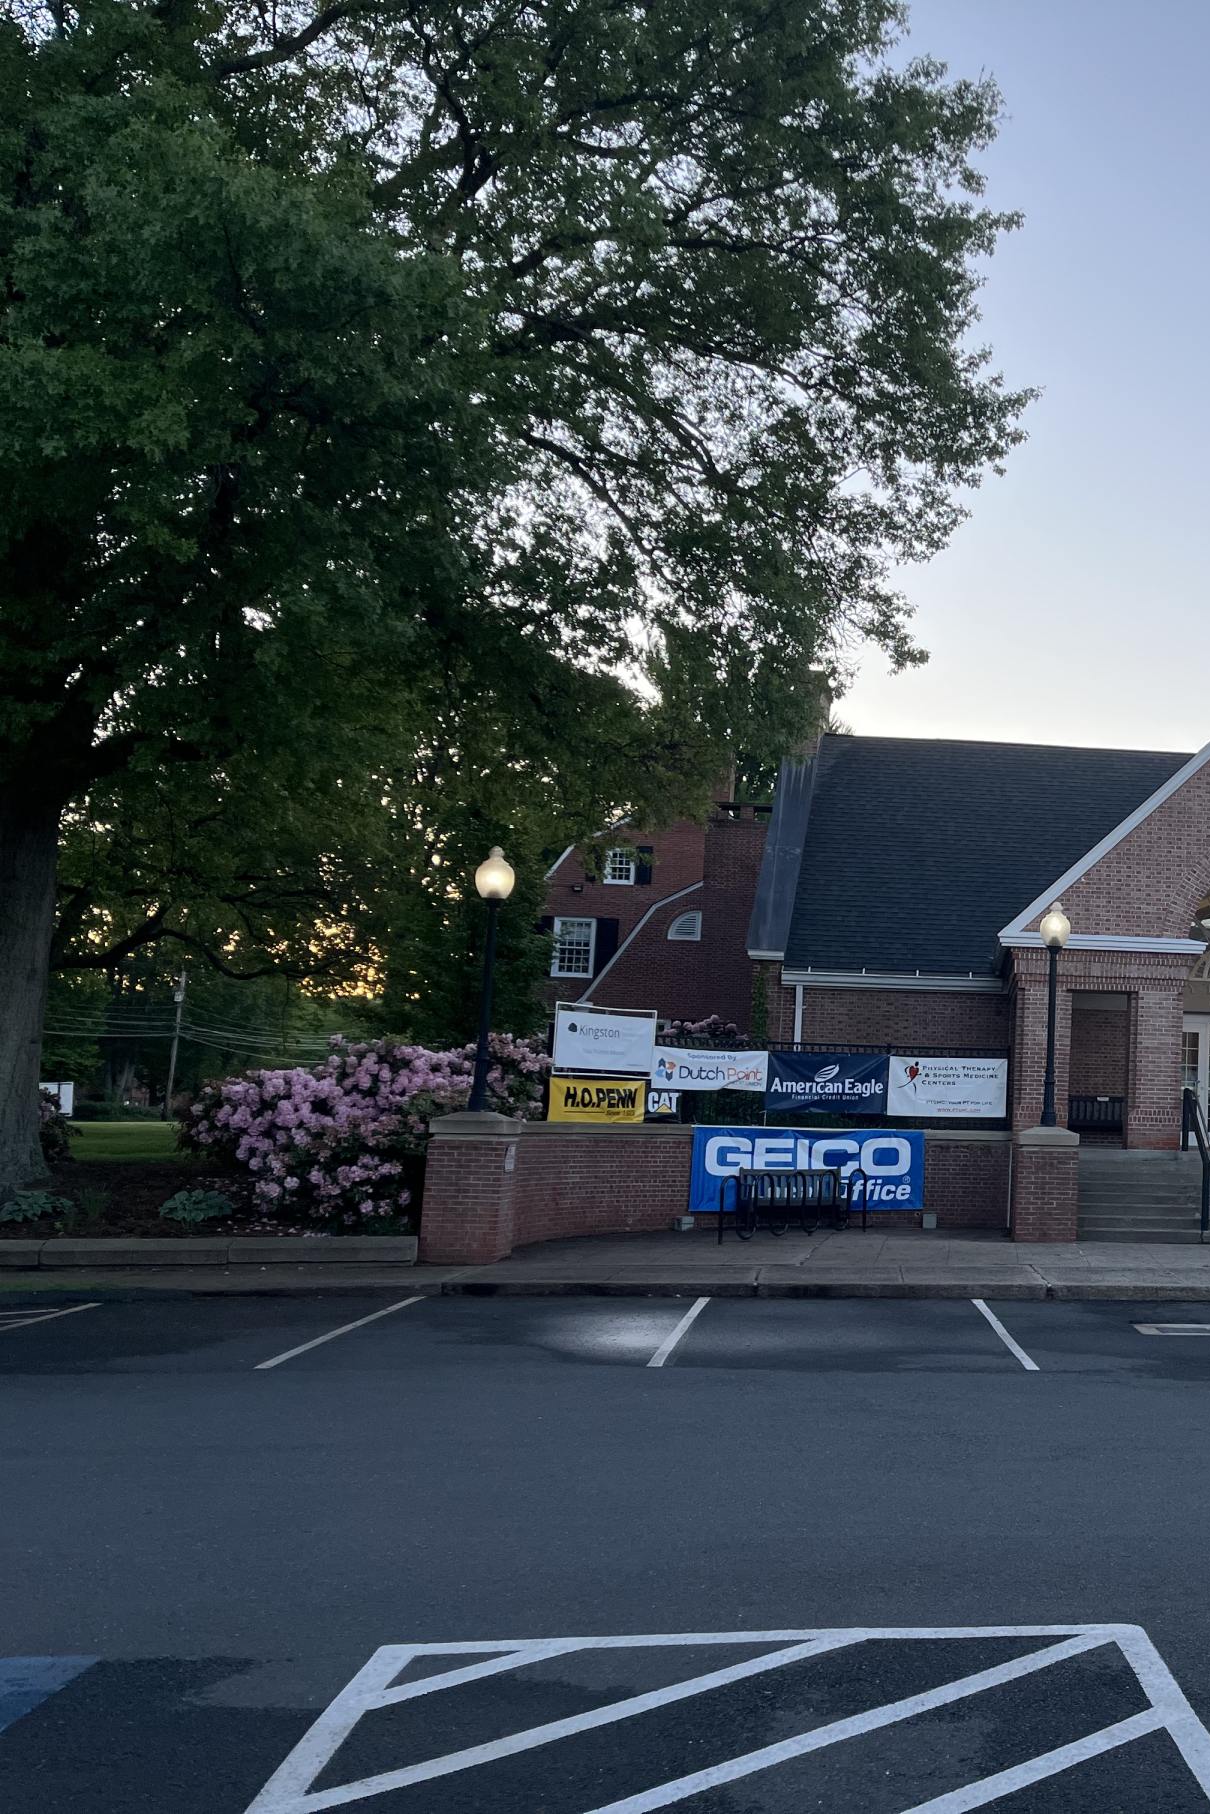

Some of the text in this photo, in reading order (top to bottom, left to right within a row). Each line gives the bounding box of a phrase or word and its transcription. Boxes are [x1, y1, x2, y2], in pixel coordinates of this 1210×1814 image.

[578, 1024, 620, 1040] Kingston
[678, 1065, 763, 1082] Dutch Point
[770, 1077, 884, 1097] American Eagle
[647, 1091, 679, 1113] CAT
[704, 1136, 912, 1177] GEICO
